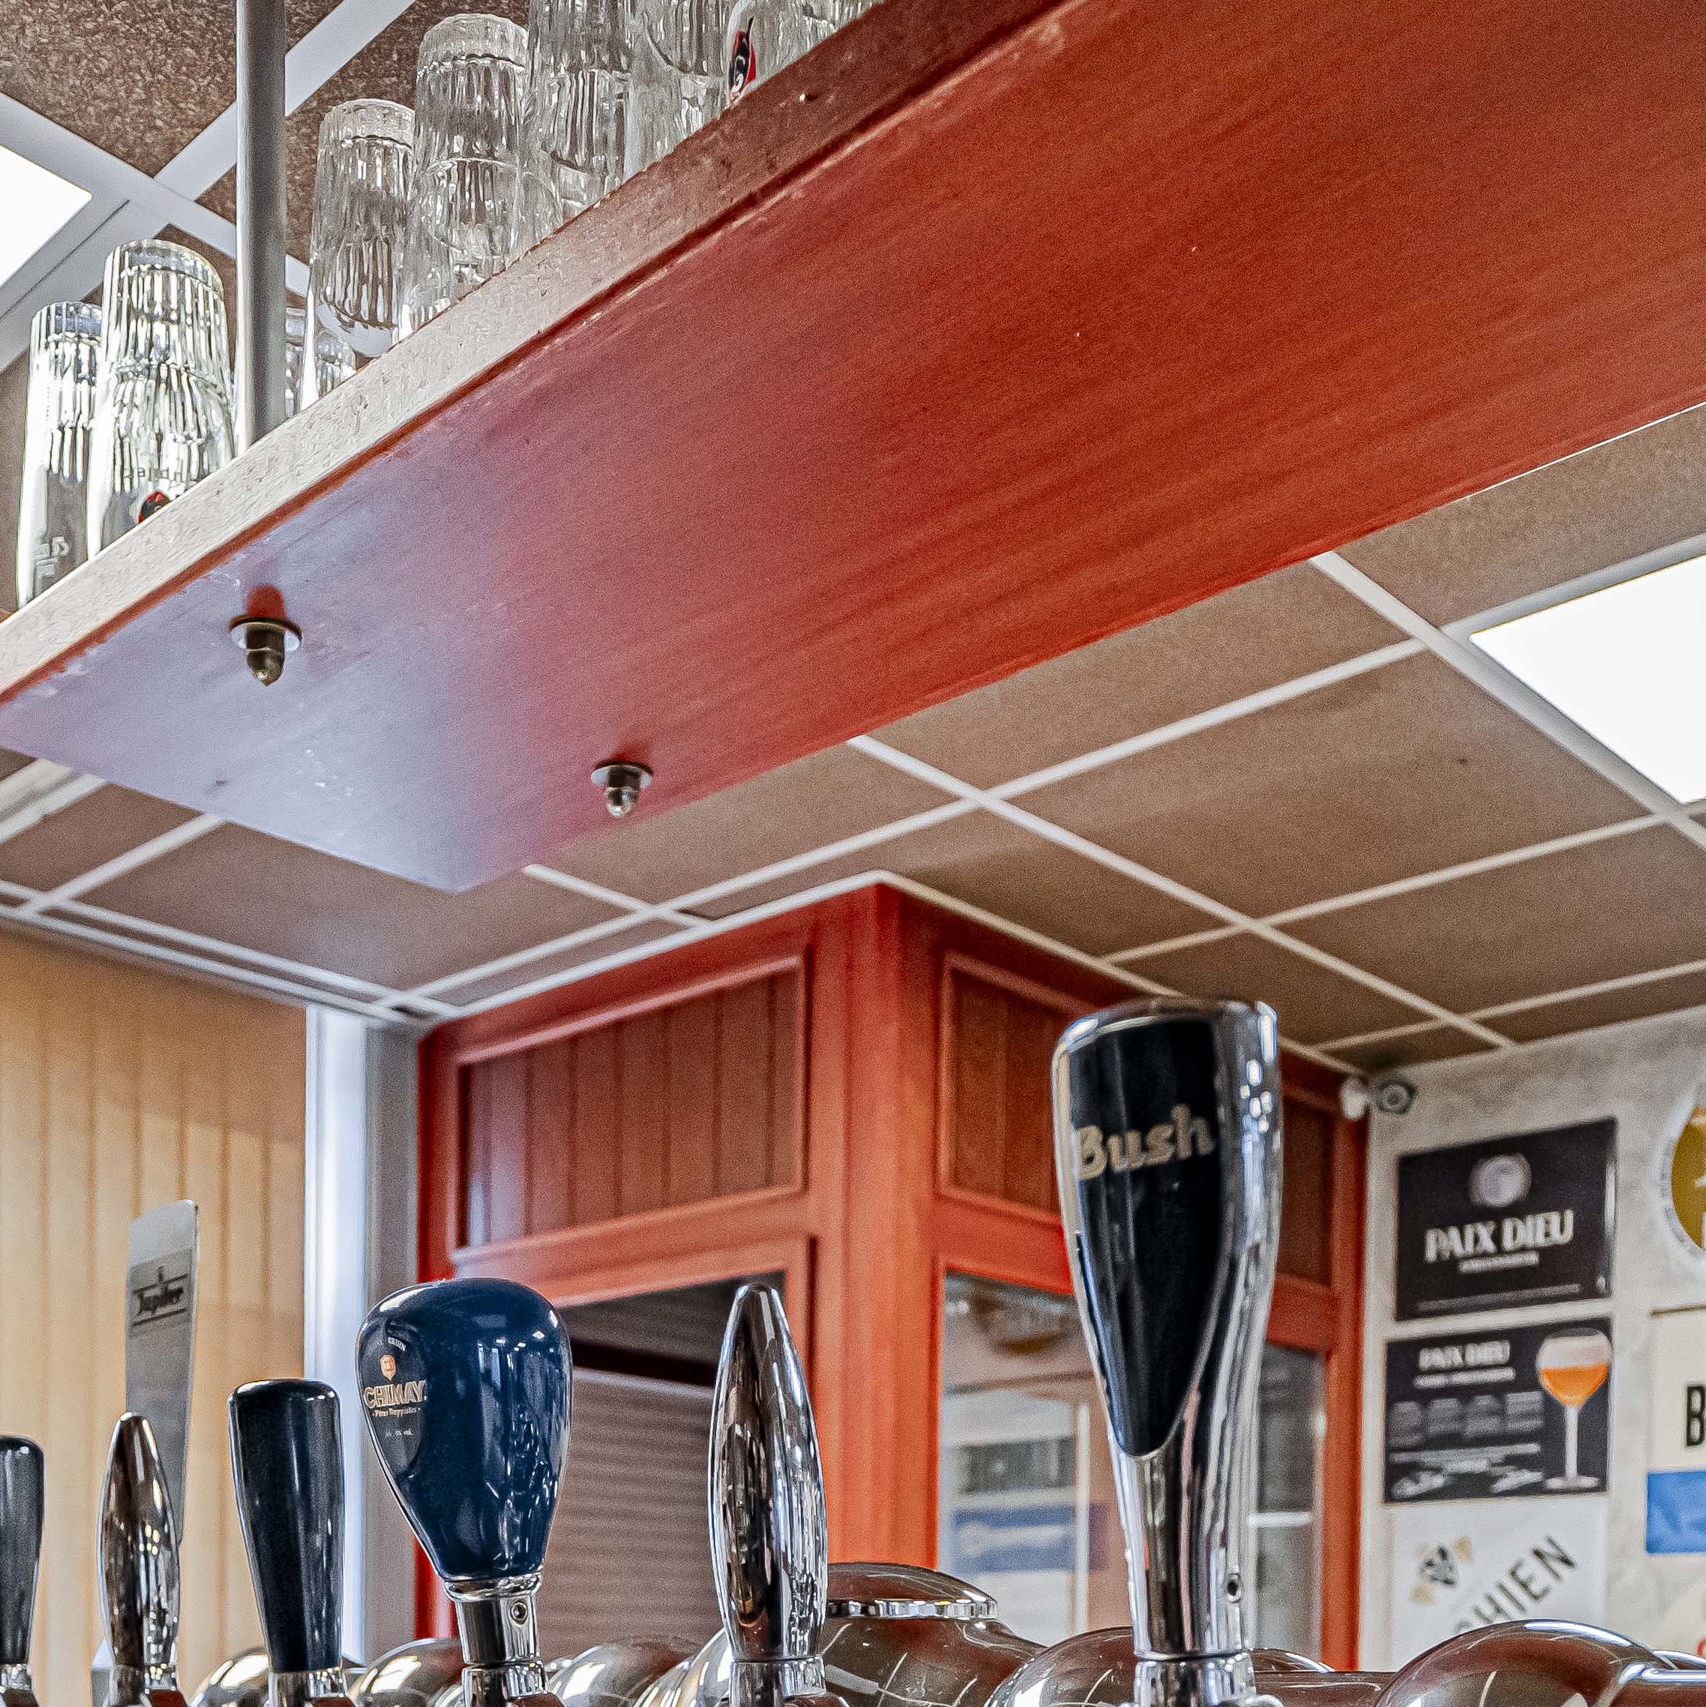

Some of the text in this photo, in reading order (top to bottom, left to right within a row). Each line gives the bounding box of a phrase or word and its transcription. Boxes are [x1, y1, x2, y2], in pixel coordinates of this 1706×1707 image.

[1075, 1104, 1216, 1181] Bush
[1425, 1221, 1498, 1263] PAIX
[1501, 1208, 1574, 1251] DIEU
[363, 1380, 426, 1409] CHIMAY
